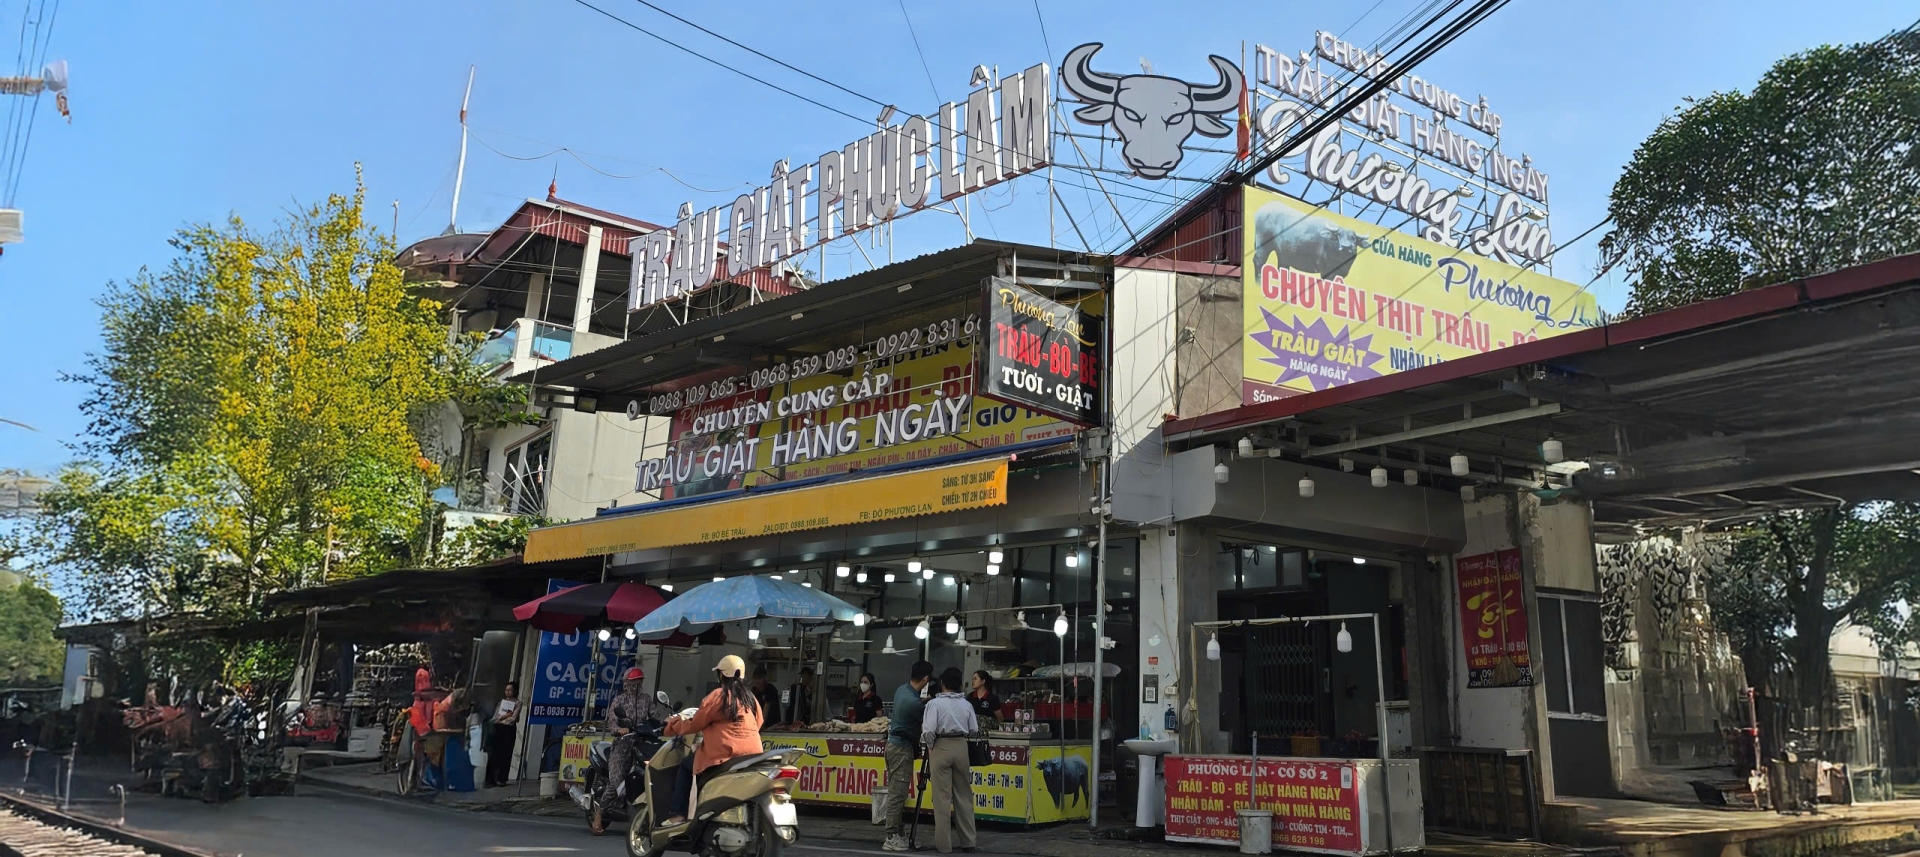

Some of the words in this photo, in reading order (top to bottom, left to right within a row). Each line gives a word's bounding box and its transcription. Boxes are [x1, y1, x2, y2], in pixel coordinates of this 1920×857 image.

[1408, 75, 1462, 118] CUNG
[1257, 45, 1336, 110] TRÂU
[1410, 111, 1483, 173] HÀNG
[1491, 152, 1550, 200] NGÀY
[629, 201, 720, 311] TRÂU
[729, 158, 812, 281] GIẬT
[818, 104, 933, 244] PHÚC
[939, 62, 1051, 201] LÂM
[1470, 191, 1556, 270] Lan
[1398, 243, 1433, 268] HÀNG
[1437, 256, 1556, 329] Phương
[1262, 264, 1366, 323] CHUYÊN
[1373, 294, 1424, 342] THỊT
[1431, 308, 1491, 353] TRÂU
[1271, 329, 1320, 357] TRÂU
[1323, 342, 1367, 371] GIẬT
[650, 391, 681, 415] 0988
[685, 385, 706, 406] 109
[710, 376, 735, 399] 865
[751, 363, 788, 389] 0968
[792, 355, 821, 379] 559
[826, 345, 857, 370] 093
[876, 328, 921, 357] 0922
[928, 317, 959, 344] 831
[1290, 358, 1318, 374] HÀNG
[1320, 365, 1348, 381] NGÀY
[693, 399, 773, 435] CHUYÊN
[777, 384, 836, 416] CUNG
[843, 365, 891, 402] CẤP
[1002, 365, 1044, 395] TƯƠI
[1055, 385, 1093, 411] GIẬT
[634, 445, 695, 493] TRÂU
[704, 431, 761, 482] GIẬT
[771, 418, 858, 467] HÀNG
[875, 389, 968, 447] NGÀY
[969, 473, 977, 485] 3H
[979, 470, 996, 483] SÁNG
[970, 491, 977, 502] 2H
[859, 511, 870, 520] FB:
[918, 503, 933, 512] LAN
[549, 687, 565, 699] GP
[533, 706, 545, 716] ĐT:
[547, 706, 565, 716] 0936
[843, 744, 854, 753] ĐT
[862, 744, 884, 754] Zalo:
[999, 751, 1017, 761] 865
[800, 761, 832, 798] GIẬT
[836, 762, 877, 796] HÀNG
[974, 773, 982, 785] 3H
[988, 774, 995, 786] 5H
[1001, 774, 1010, 787] 7H
[1014, 775, 1023, 788] 9H
[1188, 763, 1239, 776] PHƯƠNG
[1277, 766, 1296, 778] CƠ
[1299, 763, 1317, 779] SỞ
[1320, 770, 1328, 780] 2
[975, 794, 987, 807] 14H
[992, 796, 1004, 809] 16H
[1177, 778, 1202, 793] TRÂU
[1211, 779, 1225, 794] BÒ
[1235, 781, 1248, 795] BÊ
[1277, 782, 1307, 799] HÀNG
[1310, 784, 1341, 800] NGÀY
[1171, 794, 1198, 812] NHẬN
[1260, 801, 1291, 816] BUÔN
[1292, 802, 1317, 818] NHÀ
[1319, 803, 1351, 820] HÀNG
[1206, 816, 1219, 825] ONG
[1289, 819, 1313, 833] CUỐNG
[1314, 825, 1328, 834] TIM
[1211, 828, 1229, 837] 0362
[1291, 835, 1307, 844] 628
[1310, 836, 1325, 845] 198
